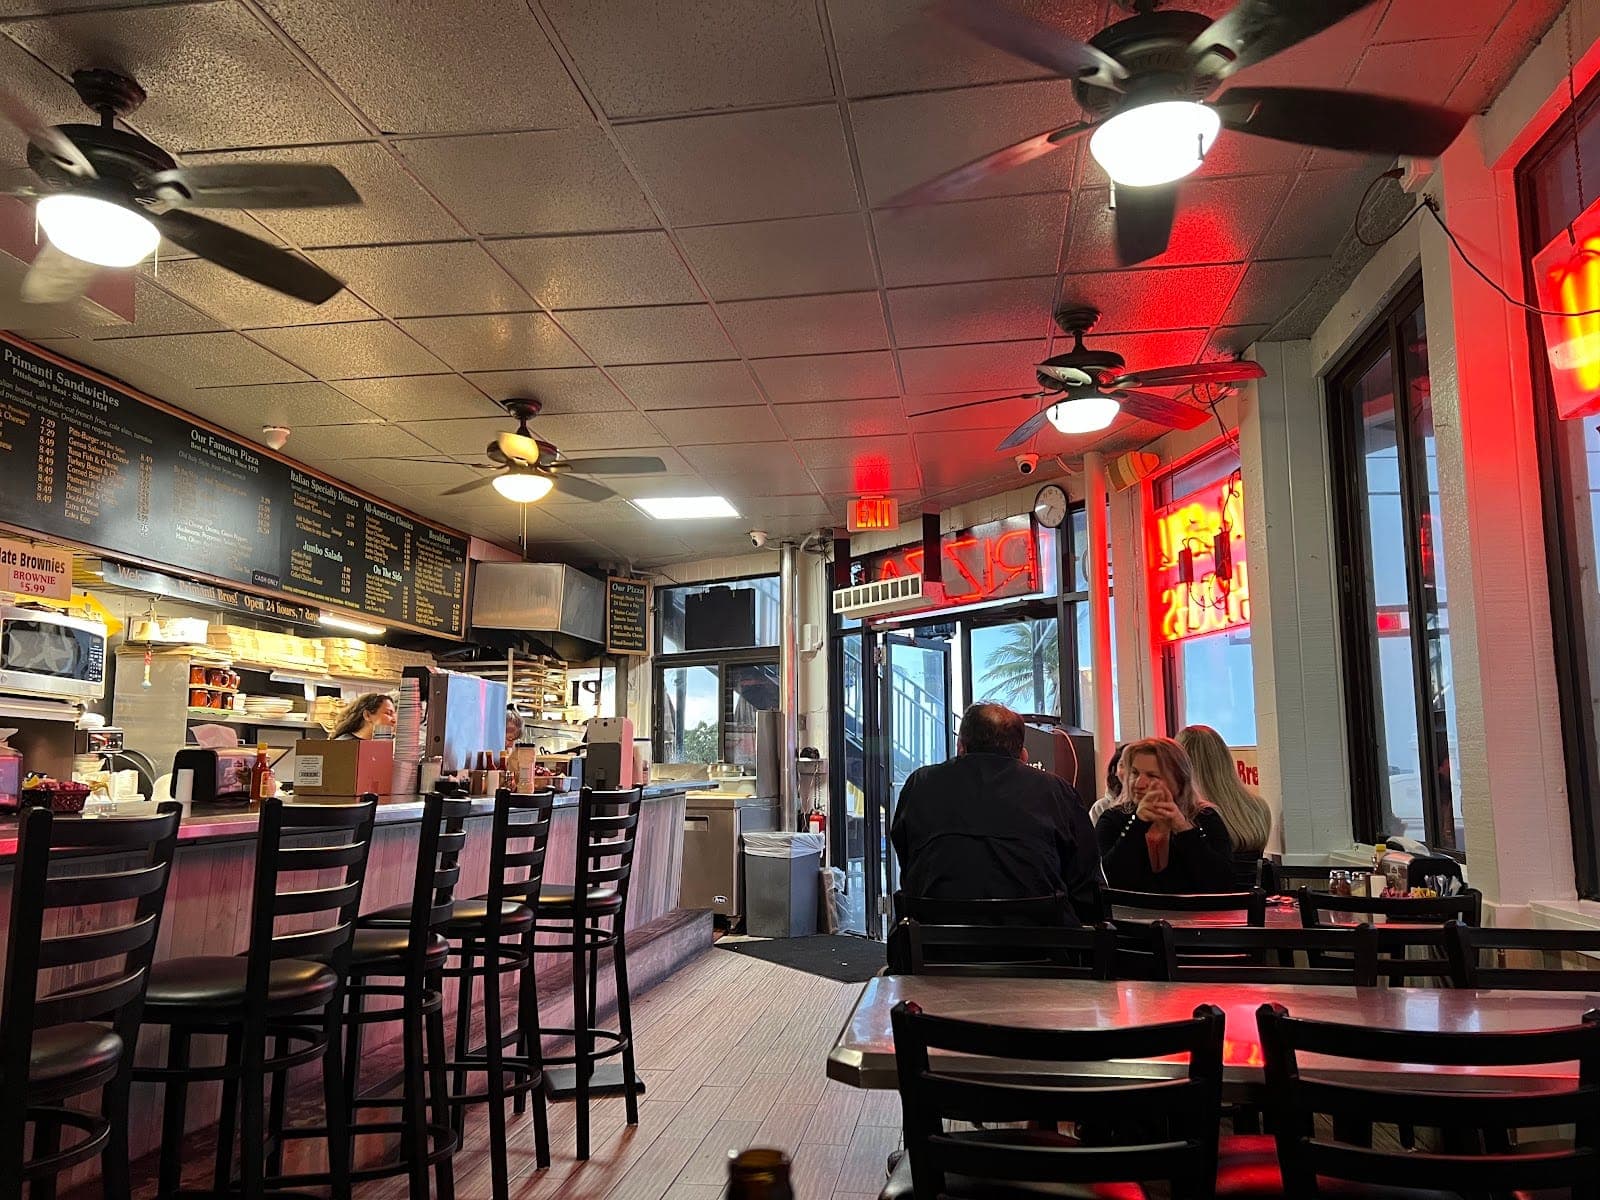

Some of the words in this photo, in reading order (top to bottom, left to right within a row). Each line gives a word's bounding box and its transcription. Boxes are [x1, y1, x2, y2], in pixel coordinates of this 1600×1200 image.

[4, 349, 53, 381] Primanti
[56, 371, 120, 407] Sandwiches
[52, 384, 67, 397] Best
[72, 393, 91, 406] Since
[92, 400, 108, 412] 1934
[4, 411, 26, 426] Cheese
[40, 416, 56, 428] 7.29
[61, 412, 82, 426] Onions
[40, 426, 55, 438] 7.29
[39, 436, 54, 447] 8.49
[190, 430, 206, 444] Our
[208, 436, 238, 458] Famous
[240, 448, 259, 466] Pizza
[38, 446, 54, 456] 8.49
[68, 446, 82, 458] Tuna
[82, 452, 94, 460] Fish
[112, 452, 129, 464] Cheese
[190, 442, 202, 451] Best
[218, 452, 232, 463] Beach
[38, 454, 54, 466] 8.49
[68, 455, 86, 469] Turkey
[38, 464, 53, 475] 8.49
[37, 474, 52, 484] 8.49
[36, 483, 52, 494] 8.49
[290, 470, 310, 488] Italian
[311, 480, 338, 500] Specialty
[338, 490, 358, 508] Dinners
[36, 492, 52, 504] 8.49
[364, 503, 396, 522] All-American
[396, 516, 414, 530] Classics
[856, 500, 890, 528] EXIT
[303, 540, 323, 556] Jumbo
[324, 548, 342, 562] Salads
[20, 552, 65, 574] Brownies
[14, 570, 56, 584] BROWNIE
[374, 564, 382, 575] On
[382, 567, 392, 578] The
[392, 571, 402, 582] Side
[20, 582, 45, 594] $5.99
[612, 584, 624, 592] Our
[627, 585, 644, 594] Pizza
[178, 580, 215, 599] Primanti
[244, 596, 264, 611] Open
[266, 600, 275, 612] 24
[276, 601, 298, 619] hours,
[298, 608, 303, 618] 7
[304, 608, 320, 624] day
